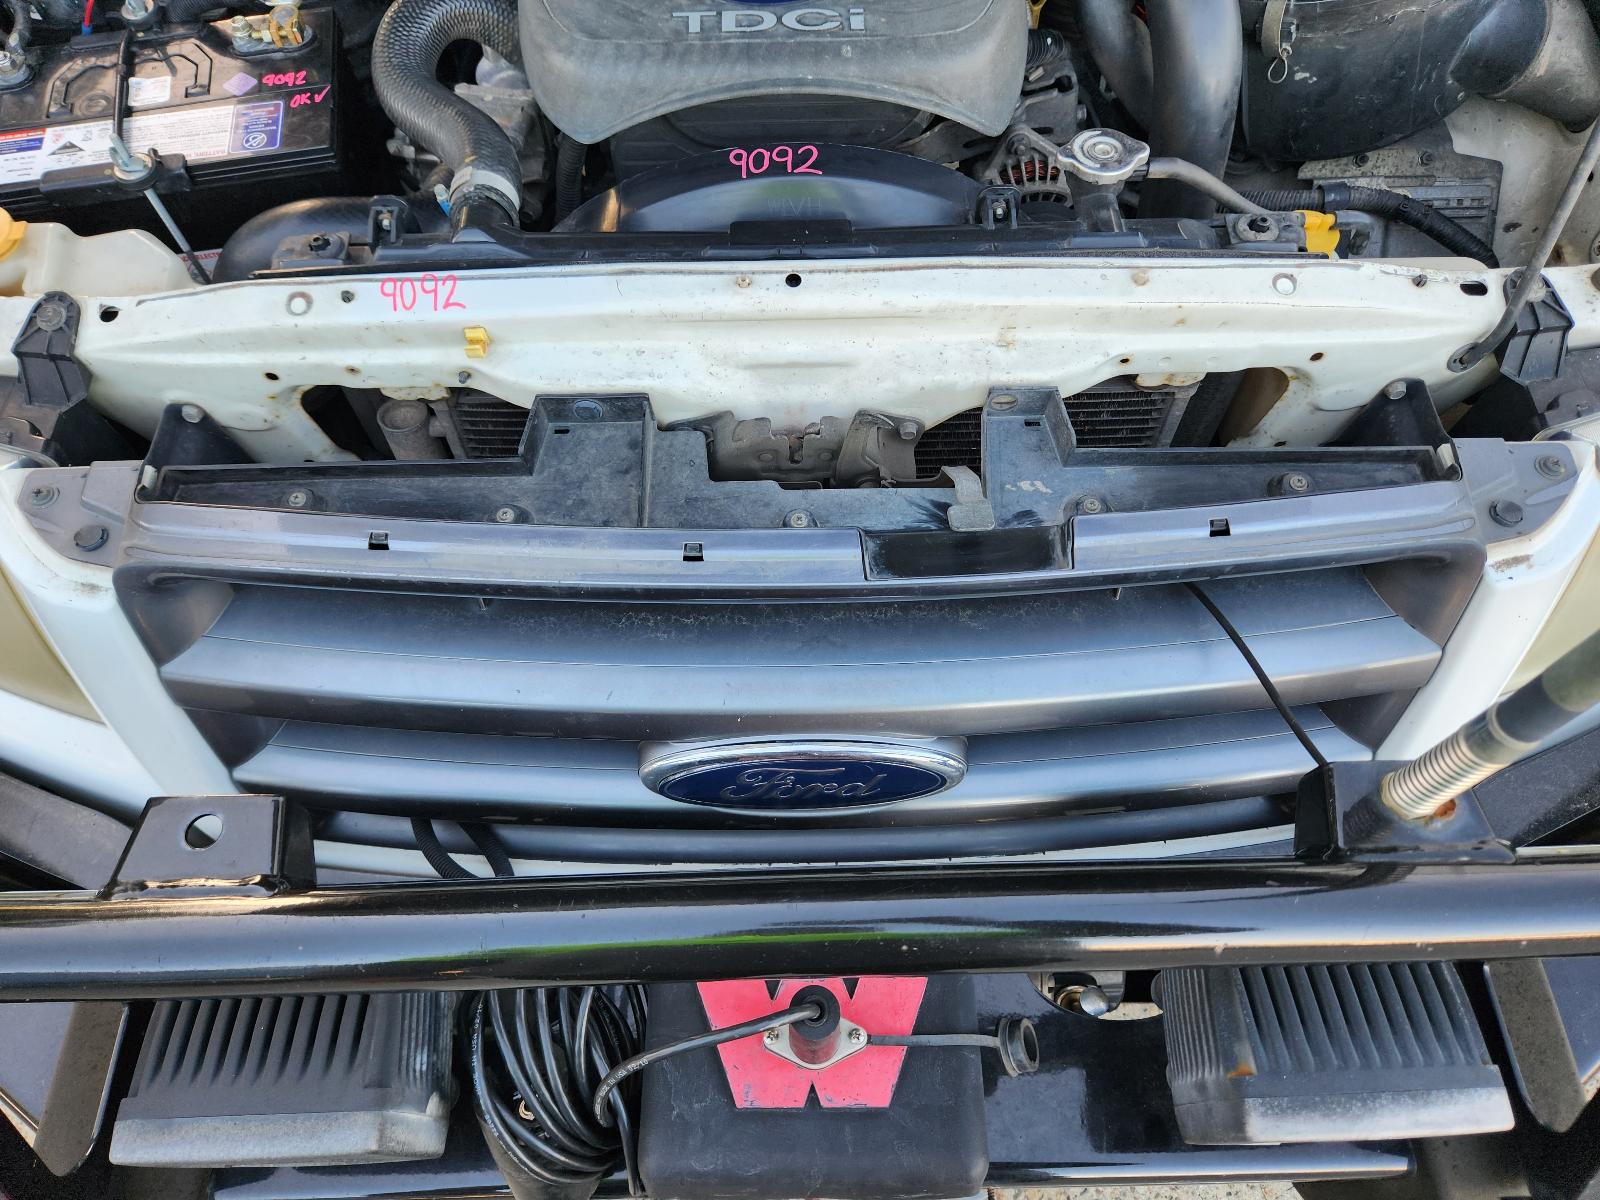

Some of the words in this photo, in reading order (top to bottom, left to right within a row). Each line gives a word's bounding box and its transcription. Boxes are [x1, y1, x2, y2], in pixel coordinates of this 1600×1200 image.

[672, 8, 865, 33] TDCi
[262, 70, 307, 87] 9092
[290, 92, 312, 108] OK
[729, 145, 823, 179] 9092
[380, 272, 467, 312] 9092
[719, 766, 888, 799] Ford
